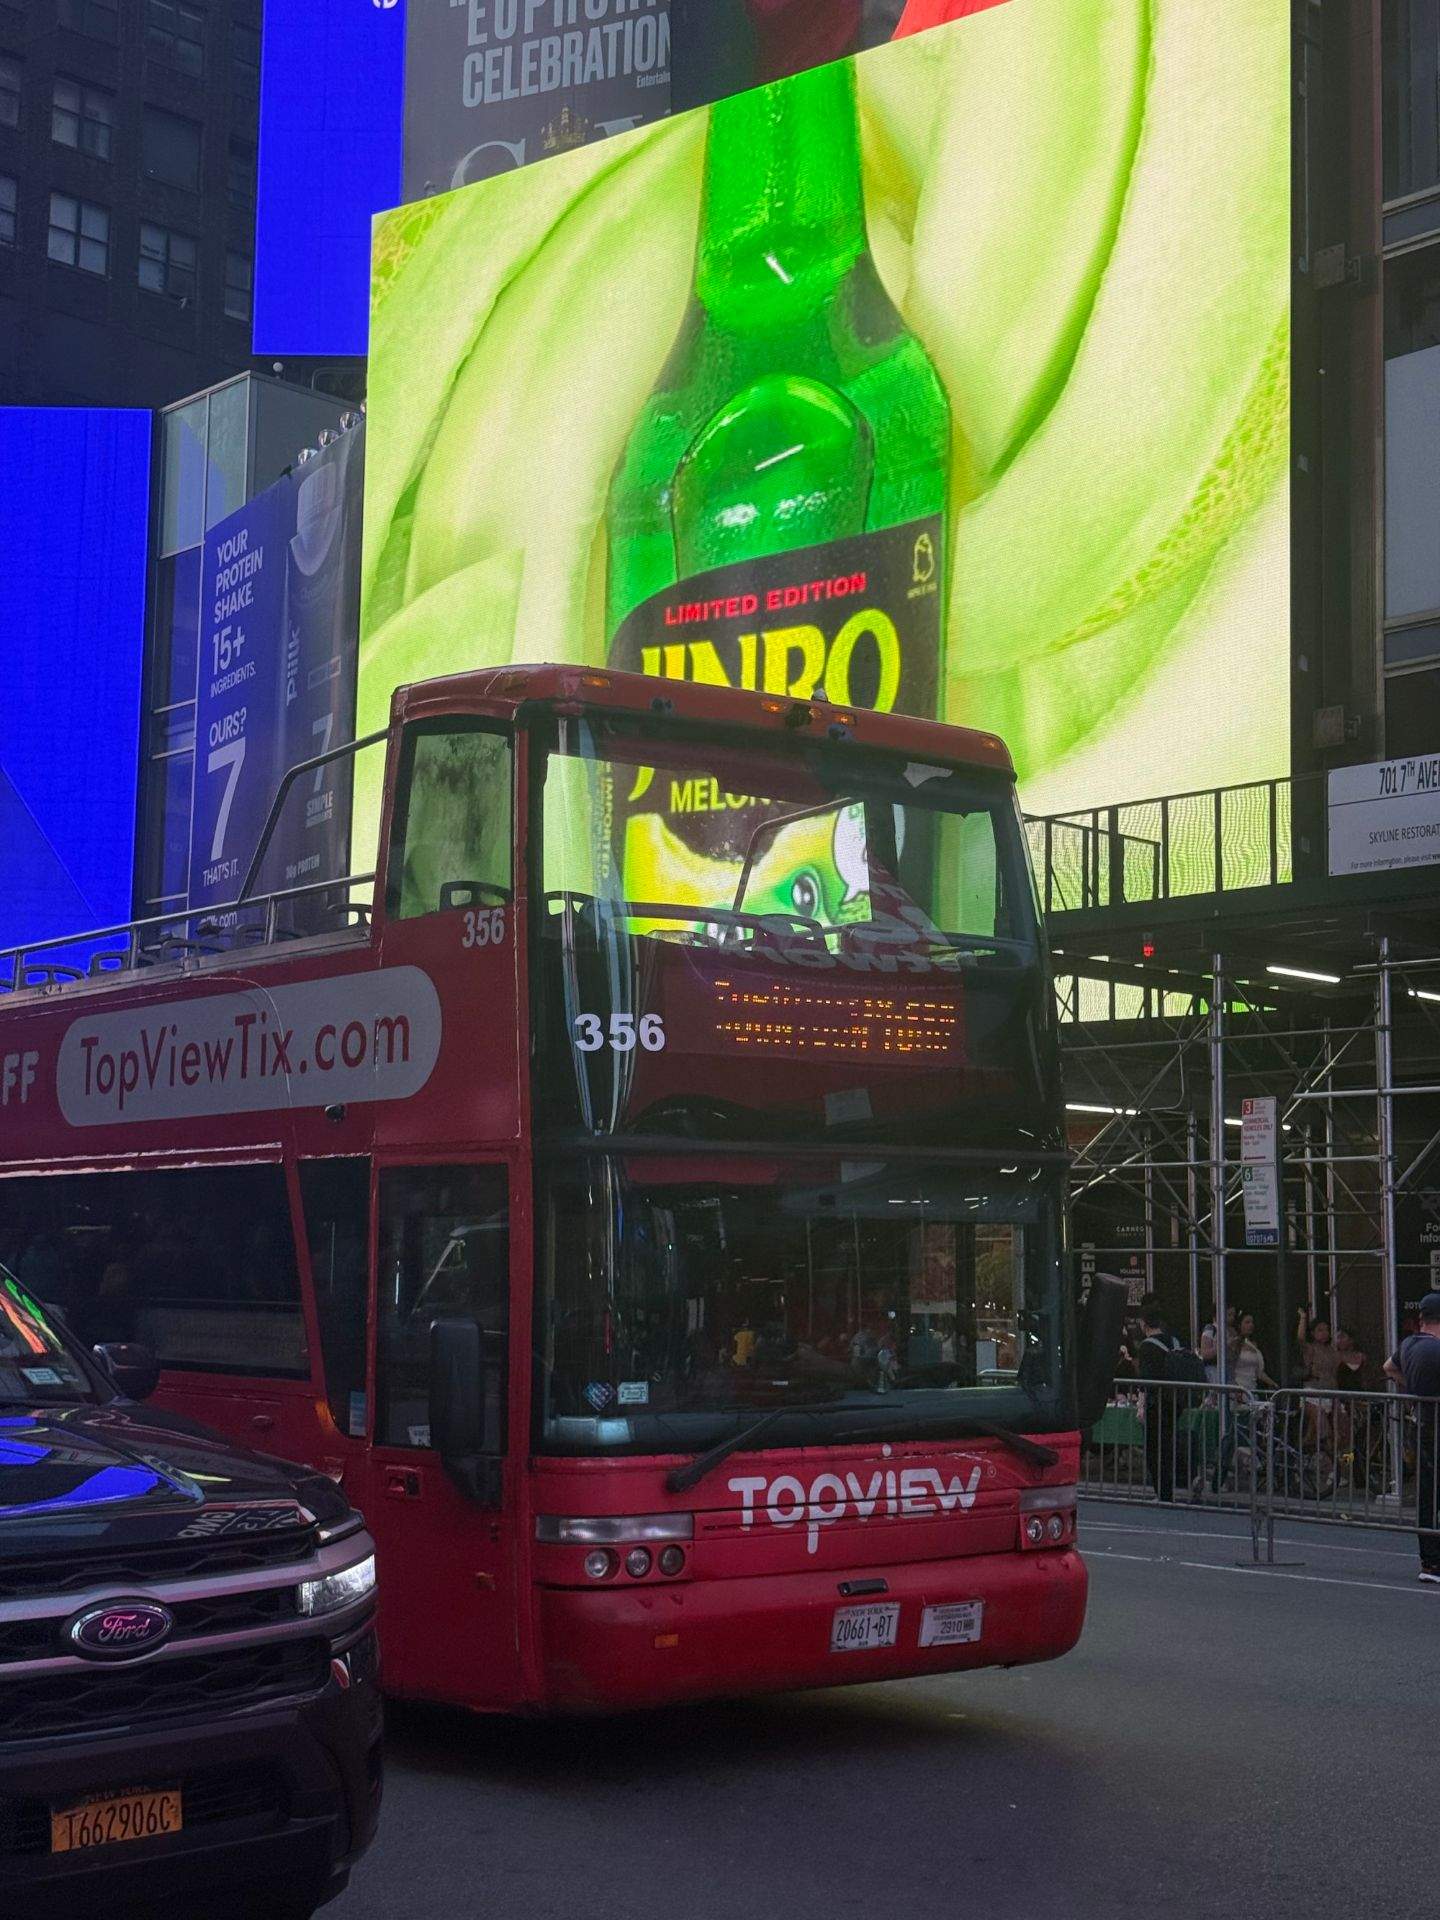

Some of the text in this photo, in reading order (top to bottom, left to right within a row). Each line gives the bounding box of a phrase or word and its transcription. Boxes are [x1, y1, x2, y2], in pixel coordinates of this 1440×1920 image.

[462, 12, 671, 108] CELEBRATION
[217, 529, 248, 567] YOUR
[215, 547, 263, 597] PROTEIN
[214, 581, 254, 624] SHAKE.
[664, 594, 757, 626] LIMITED
[766, 572, 867, 612] EDITION
[212, 625, 245, 675] 15+
[641, 607, 901, 714] NRO
[210, 661, 256, 698] INGREDIENTS.
[209, 706, 247, 747] OURS?
[312, 712, 333, 792] 7
[670, 776, 771, 813] MEL
[1379, 760, 1440, 795] 701 7TH AVE
[207, 736, 246, 862] 7
[1369, 829, 1399, 844] SKYLINE
[203, 858, 240, 887] THAT'S IT.
[461, 908, 505, 948] 356
[574, 1013, 665, 1052] 356
[80, 1011, 411, 1110] TopViewTix.com
[1245, 1168, 1251, 1181] 6
[99, 1614, 151, 1641] Ford
[64, 1796, 172, 1850] T662906C
